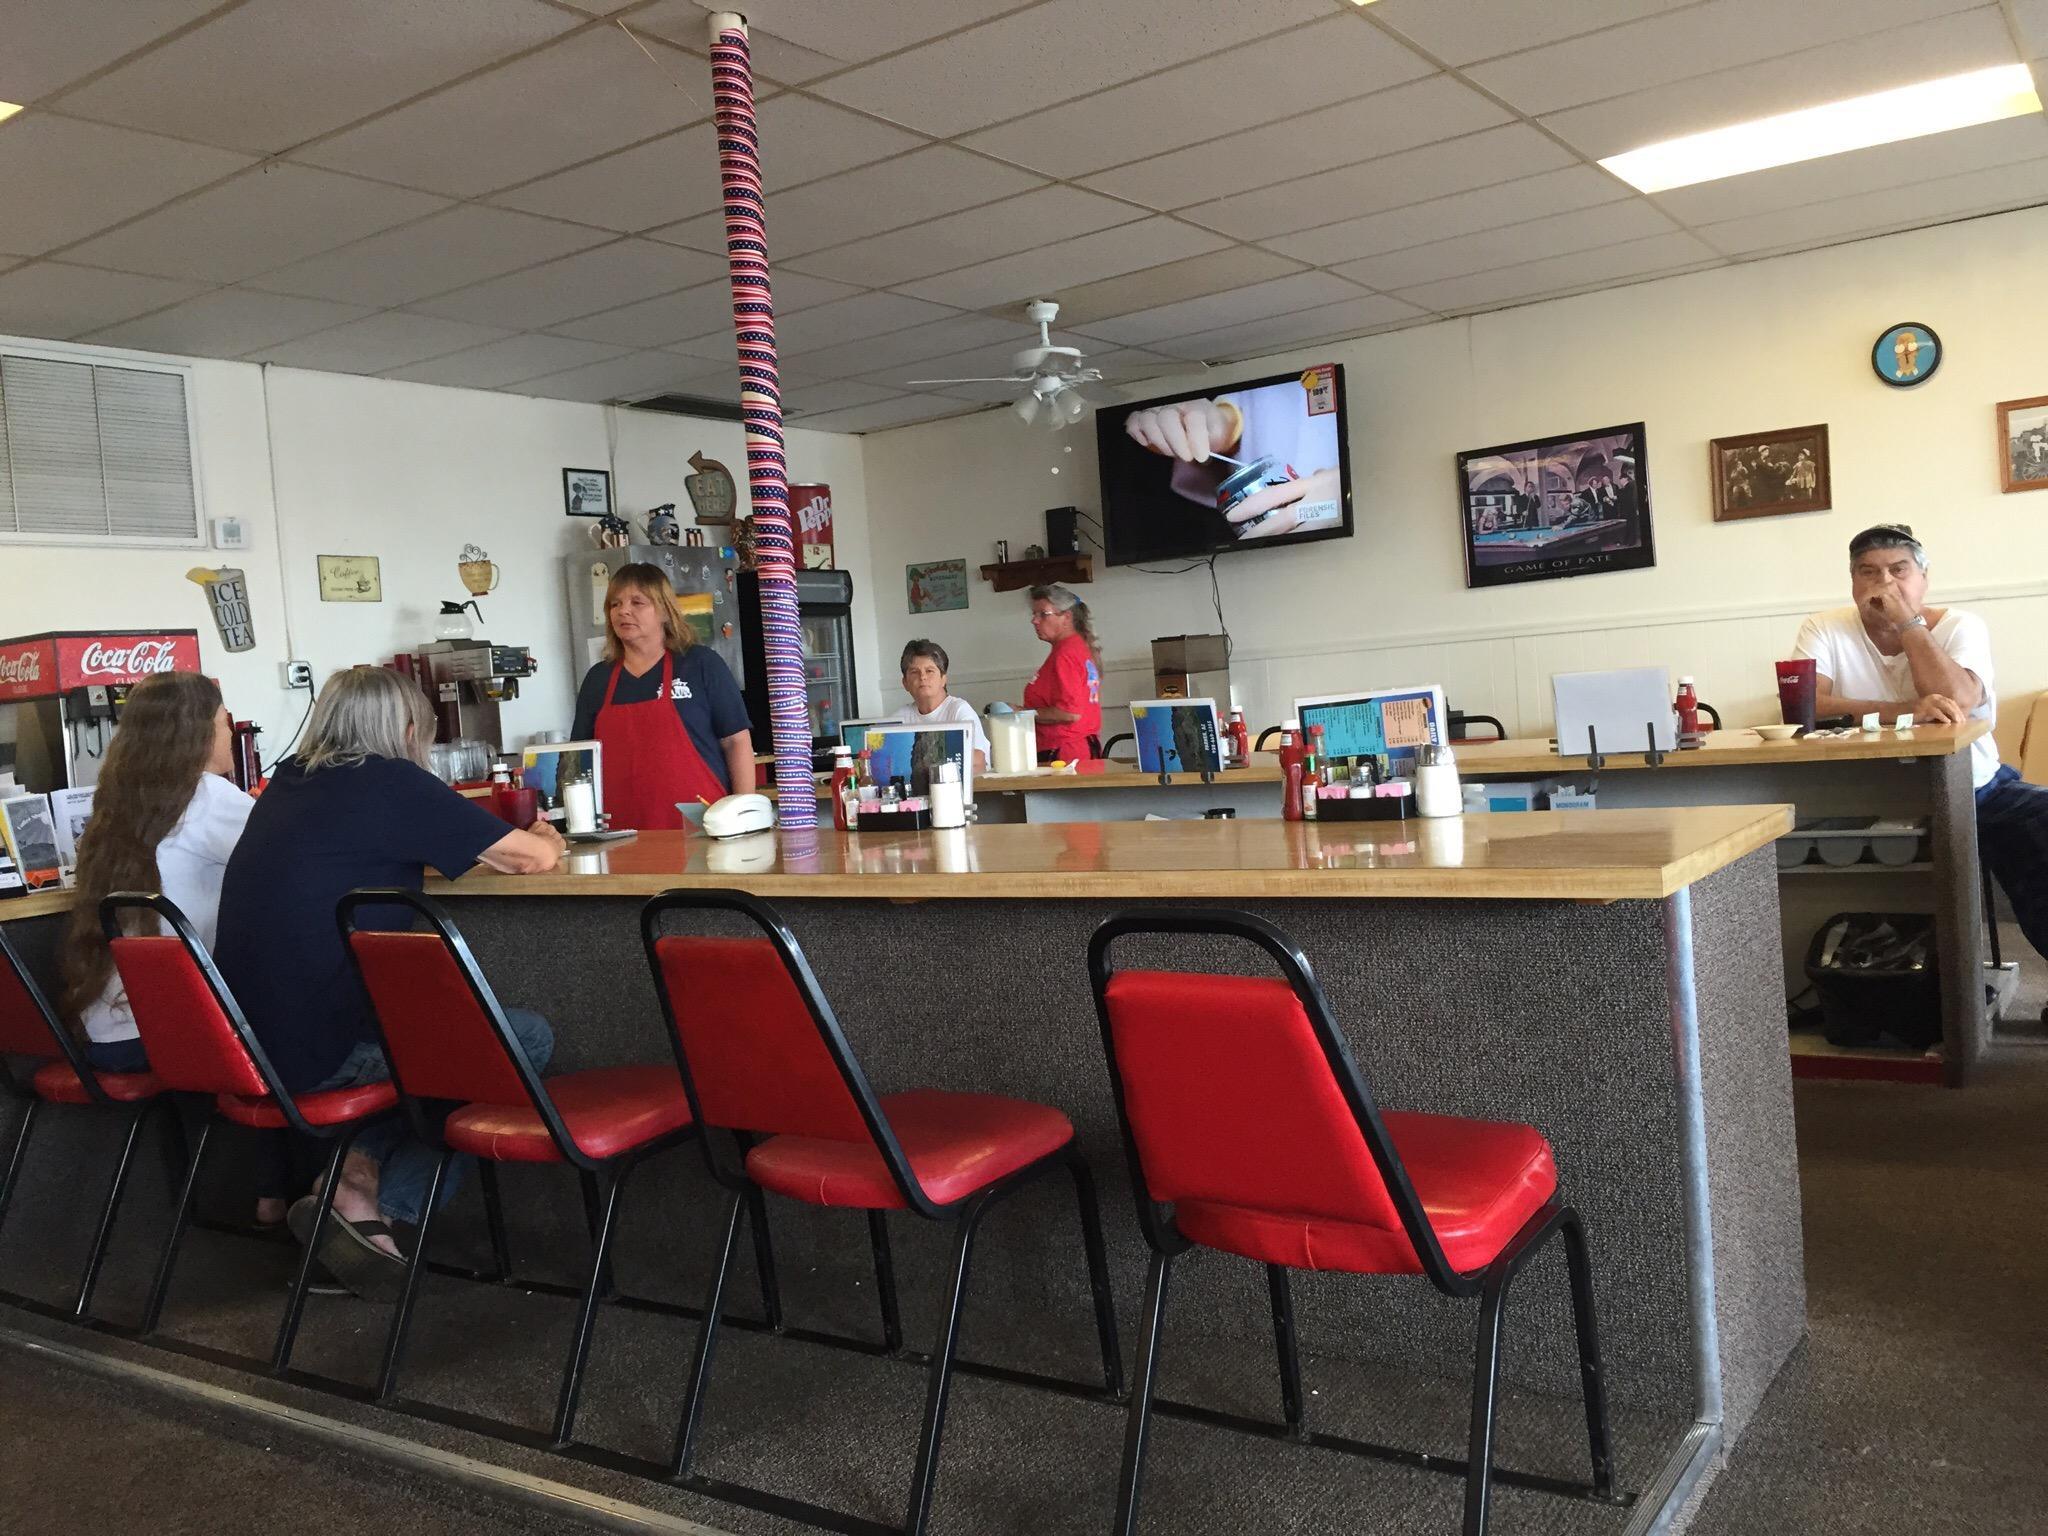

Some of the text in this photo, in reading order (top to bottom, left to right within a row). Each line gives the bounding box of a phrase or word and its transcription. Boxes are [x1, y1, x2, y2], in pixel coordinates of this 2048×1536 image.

[811, 496, 830, 511] Dr
[1299, 503, 1335, 513] FORENSIC
[1299, 511, 1320, 519] FILES
[1504, 562, 1545, 574] GAME
[1552, 559, 1570, 568] OF
[1578, 554, 1612, 565] FATE
[211, 581, 244, 604] ICE
[215, 601, 250, 627] COLD
[220, 626, 254, 649] TEA
[81, 640, 177, 675] Coca-Cola
